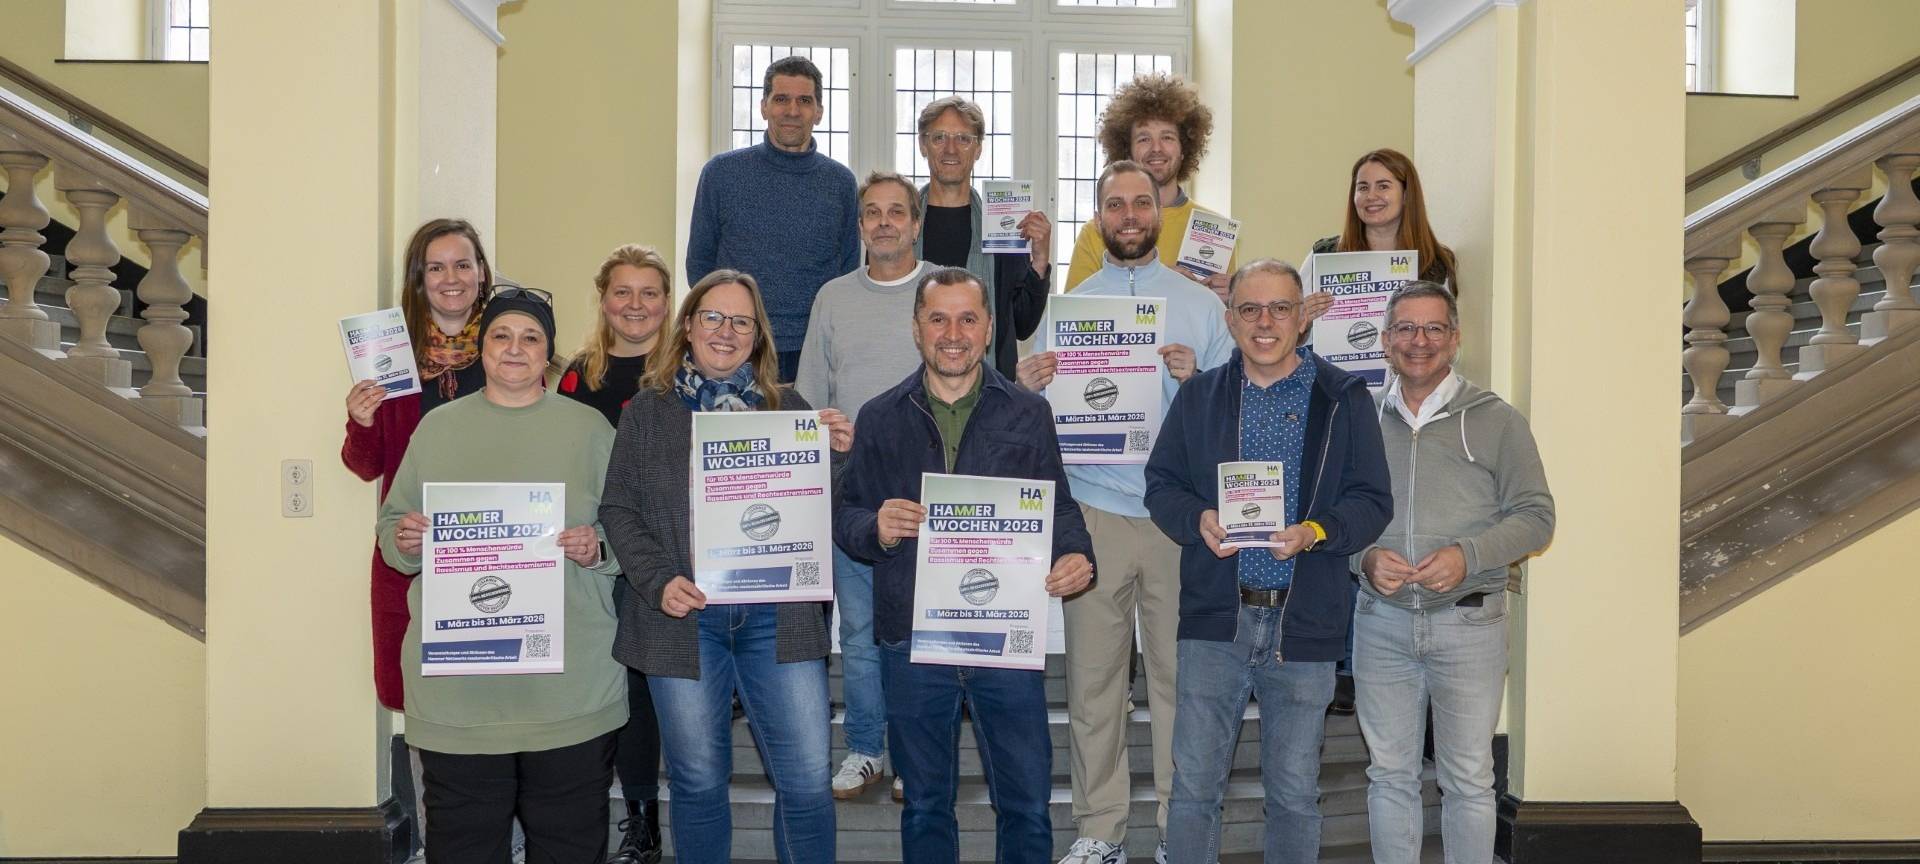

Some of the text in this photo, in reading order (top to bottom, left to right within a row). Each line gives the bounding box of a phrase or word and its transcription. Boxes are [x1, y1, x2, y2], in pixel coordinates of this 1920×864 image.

[1391, 256, 1408, 265] HA
[1323, 273, 1369, 285] HAMMER
[1136, 304, 1156, 314] HA
[1060, 321, 1112, 332] HAMMER
[1059, 333, 1152, 345] WOCHEN 2026
[795, 419, 818, 431] HA
[1065, 415, 1084, 423] März
[707, 440, 768, 455] HAMMER
[708, 452, 816, 469] WOCHEN 2026
[1226, 481, 1259, 489] WOCHEN
[529, 491, 553, 503] HA
[1020, 488, 1042, 500] HA
[933, 505, 992, 516] HAMMER
[437, 511, 500, 526] HAMMER
[933, 519, 1039, 532] WOCHEN 2026
[437, 526, 509, 540] WOCHEN
[466, 543, 522, 553] Menschenwürde
[742, 546, 756, 554] bis
[757, 545, 768, 553] 31.
[769, 544, 791, 553] März
[792, 542, 813, 551] 2026
[436, 555, 475, 564] Zusammen
[937, 609, 958, 618] März
[959, 609, 972, 618] bis
[973, 610, 985, 618] 31.
[985, 610, 1007, 618] März
[1008, 610, 1029, 618] 2026
[436, 614, 544, 629] 1. März bis 31. März 2026
